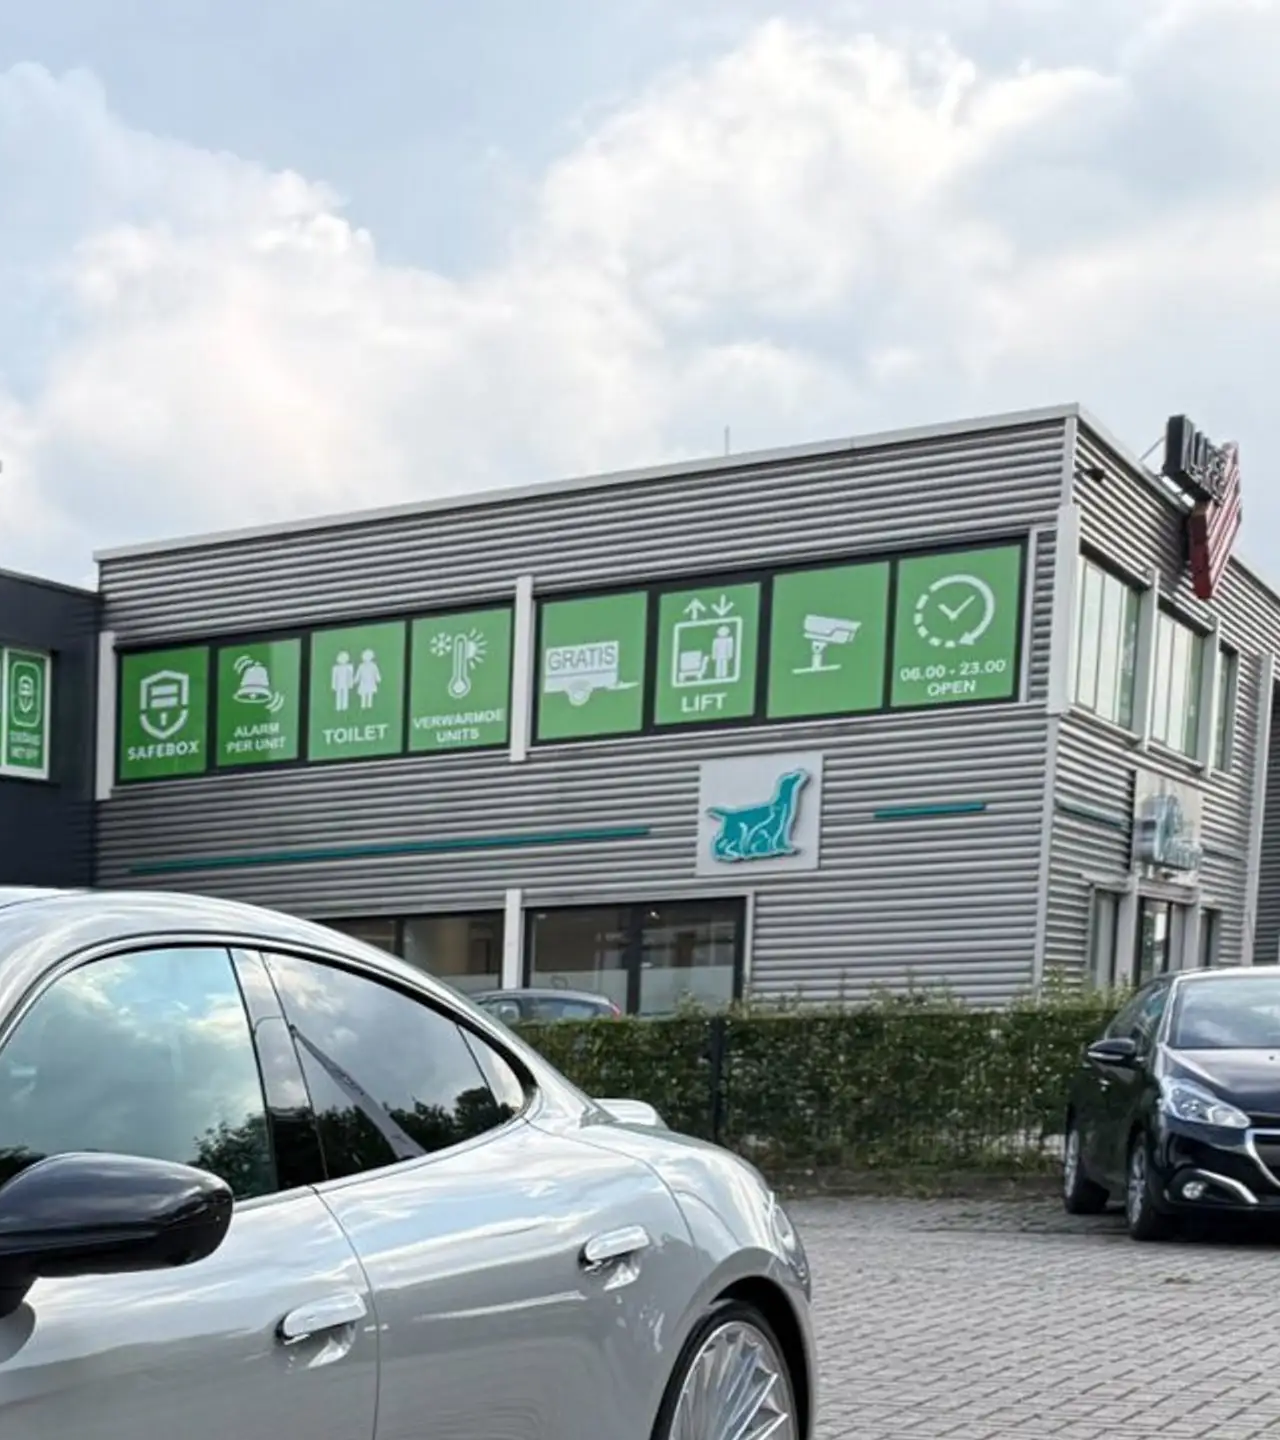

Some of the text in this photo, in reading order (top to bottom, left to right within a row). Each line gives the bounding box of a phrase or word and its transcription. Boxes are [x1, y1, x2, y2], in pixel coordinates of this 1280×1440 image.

[548, 645, 616, 671] GRATIS
[959, 660, 1007, 675] 23.00
[927, 679, 976, 696] OPEN
[681, 693, 727, 712] LIFT
[234, 722, 280, 738] ALARM
[322, 724, 388, 745] TOILET
[436, 727, 480, 742] UNITS
[128, 740, 200, 760] SAFEBOX
[226, 737, 286, 754] PER UNIT
